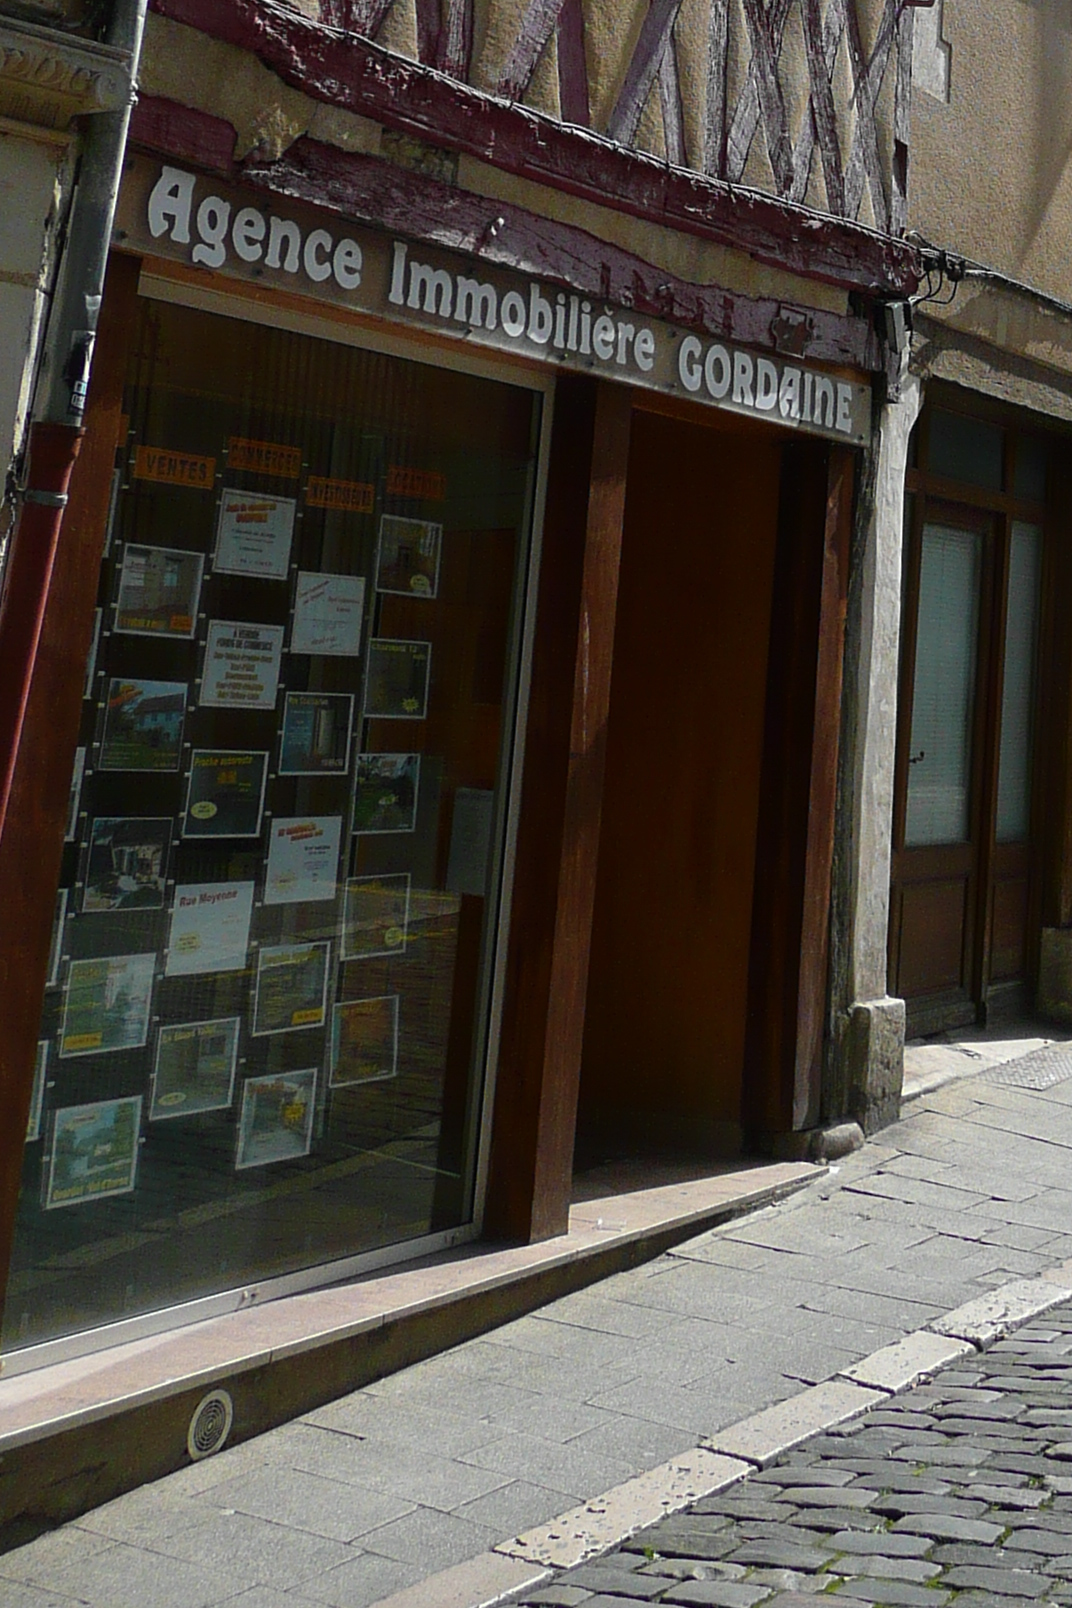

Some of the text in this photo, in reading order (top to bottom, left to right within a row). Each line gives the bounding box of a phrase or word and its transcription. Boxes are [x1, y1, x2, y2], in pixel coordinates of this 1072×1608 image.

[148, 165, 362, 291] Agence
[388, 242, 655, 372] Immobilière
[146, 454, 207, 481] VENTES
[179, 896, 197, 908] Rue
